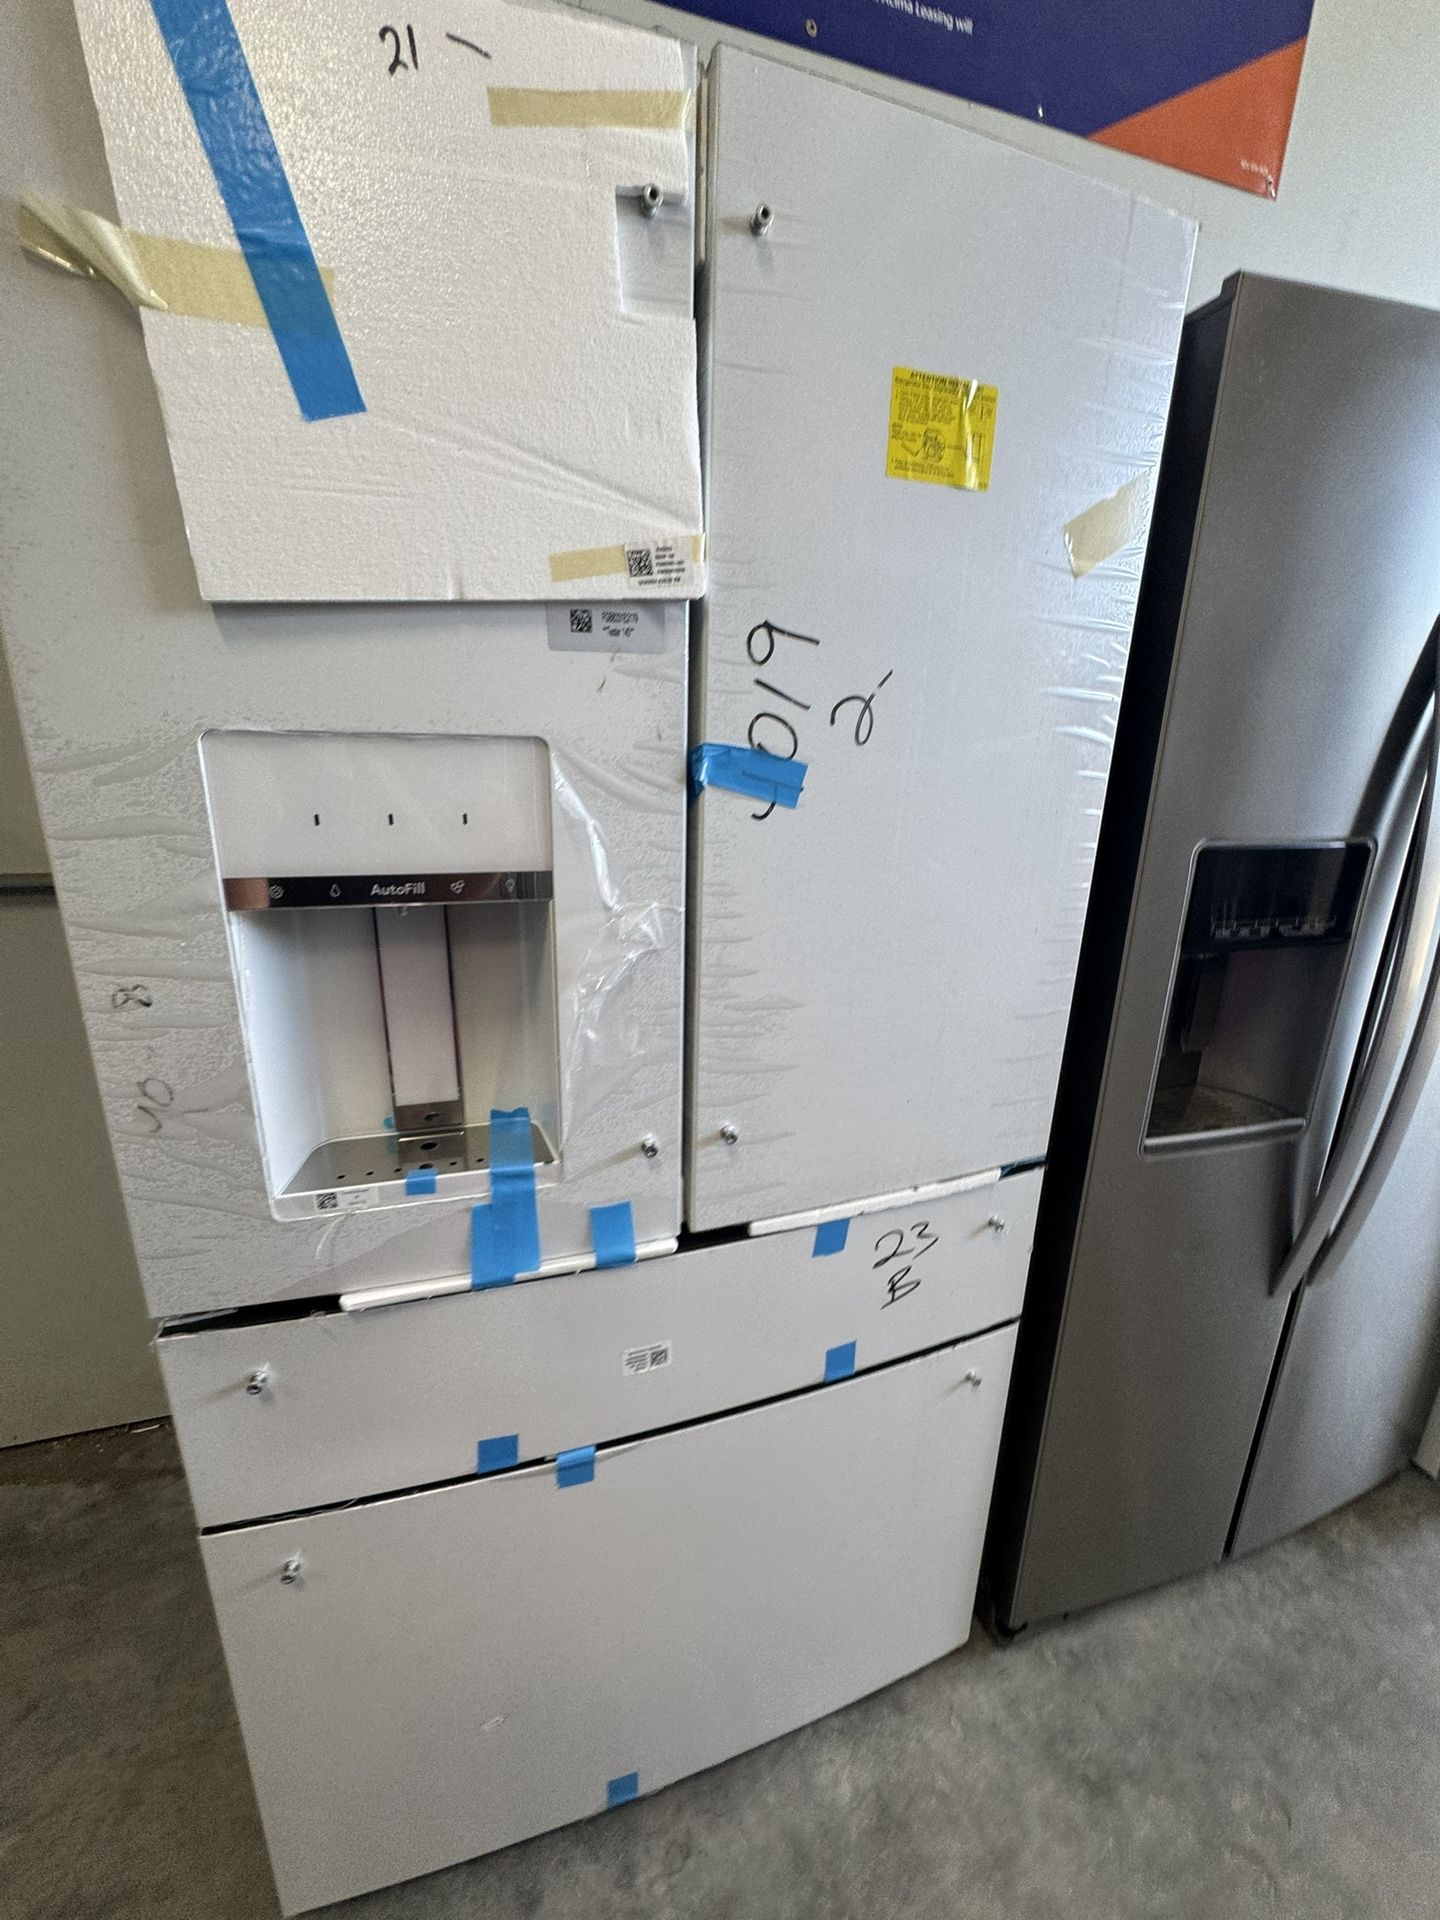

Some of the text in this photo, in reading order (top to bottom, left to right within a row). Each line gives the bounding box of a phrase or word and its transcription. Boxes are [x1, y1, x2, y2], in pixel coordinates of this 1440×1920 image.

[915, 0, 954, 32] Leasing
[955, 16, 973, 36] will
[378, 23, 419, 76] 21
[370, 881, 426, 896] AutoFill
[873, 1220, 940, 1270] 23
